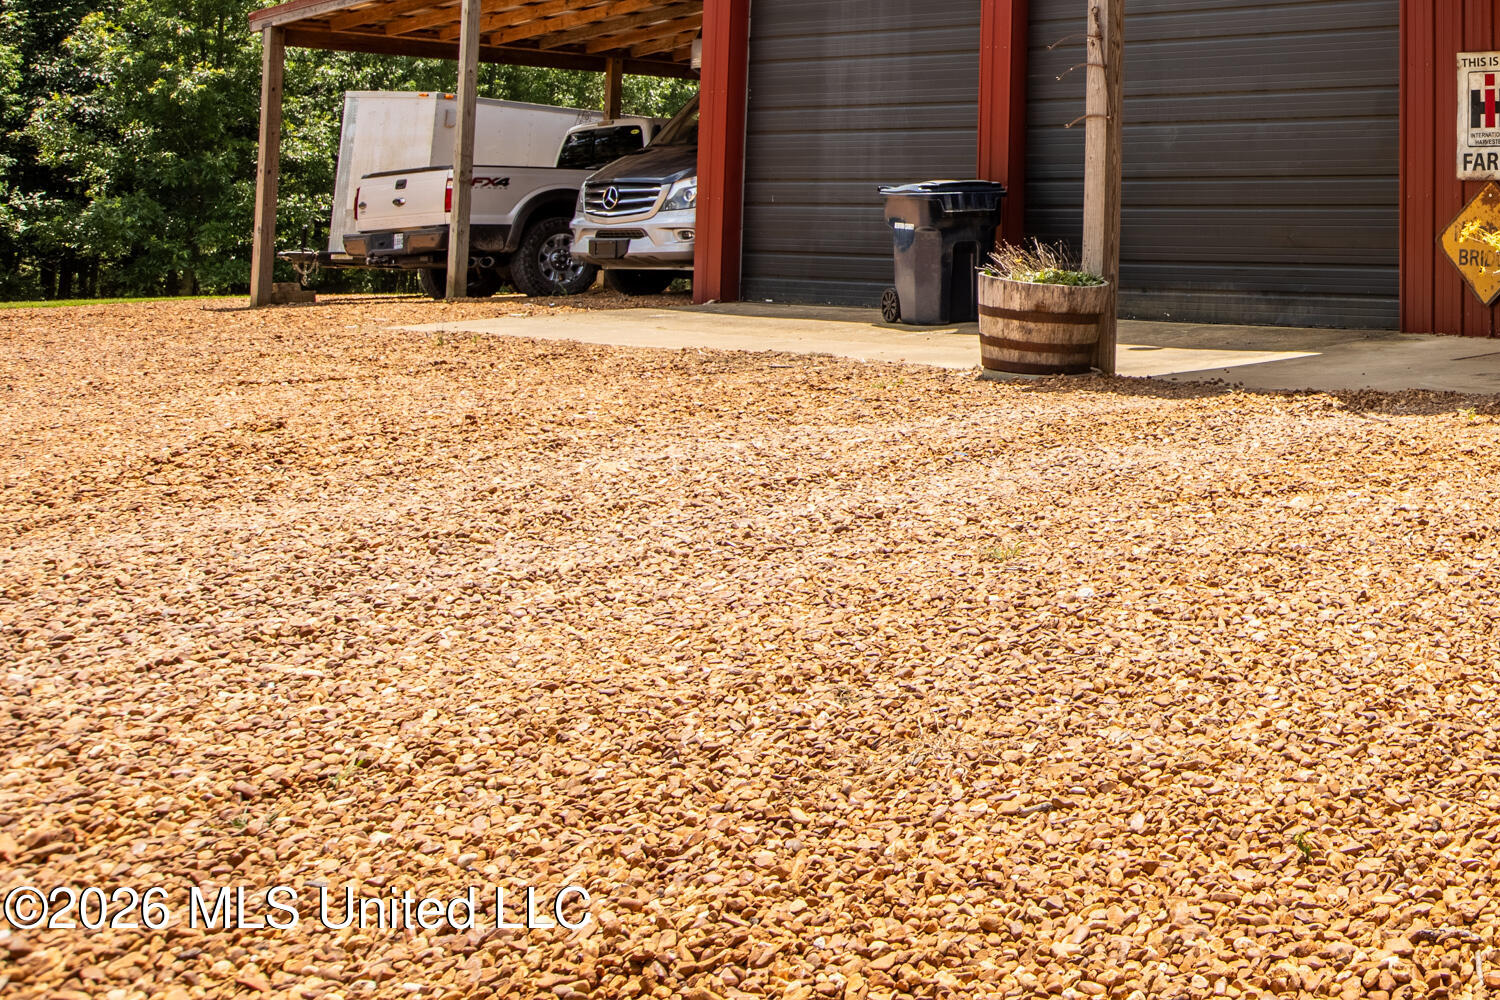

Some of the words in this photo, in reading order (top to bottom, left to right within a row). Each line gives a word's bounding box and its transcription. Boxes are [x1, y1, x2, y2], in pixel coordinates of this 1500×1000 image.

[1461, 57, 1486, 68] THIS
[1489, 56, 1498, 66] IS
[471, 176, 510, 187] FX4
